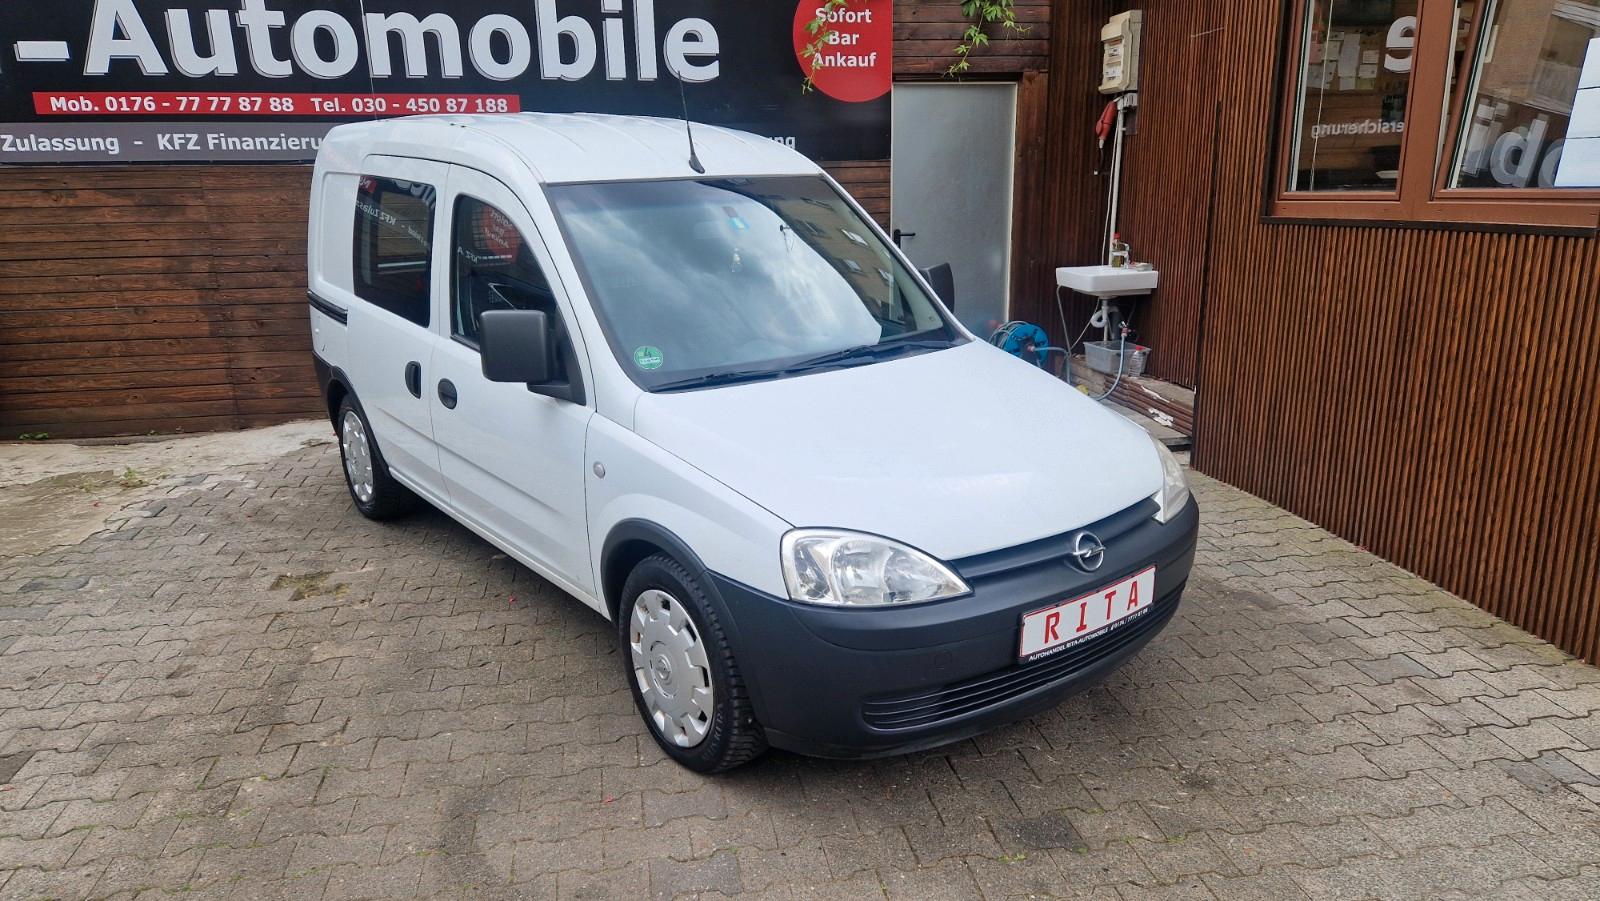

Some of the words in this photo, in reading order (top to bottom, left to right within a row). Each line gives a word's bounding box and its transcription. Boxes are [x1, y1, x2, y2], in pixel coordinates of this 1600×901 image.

[815, 7, 872, 23] Sofort
[828, 30, 860, 45] Bar
[811, 51, 877, 68] Ankauf
[50, 96, 99, 112] Mob.
[105, 97, 155, 112] 0176
[176, 97, 200, 111] 77
[207, 97, 231, 111] 77
[239, 97, 263, 111] 87
[270, 97, 294, 112] 88
[311, 97, 346, 112] Tel.
[352, 98, 387, 113] 030
[406, 98, 440, 113] 450
[446, 98, 469, 113] 87
[475, 98, 508, 113] 188
[0, 133, 119, 155] Zulassung
[157, 134, 201, 151] KFZ
[207, 133, 322, 151] Finanzieru
